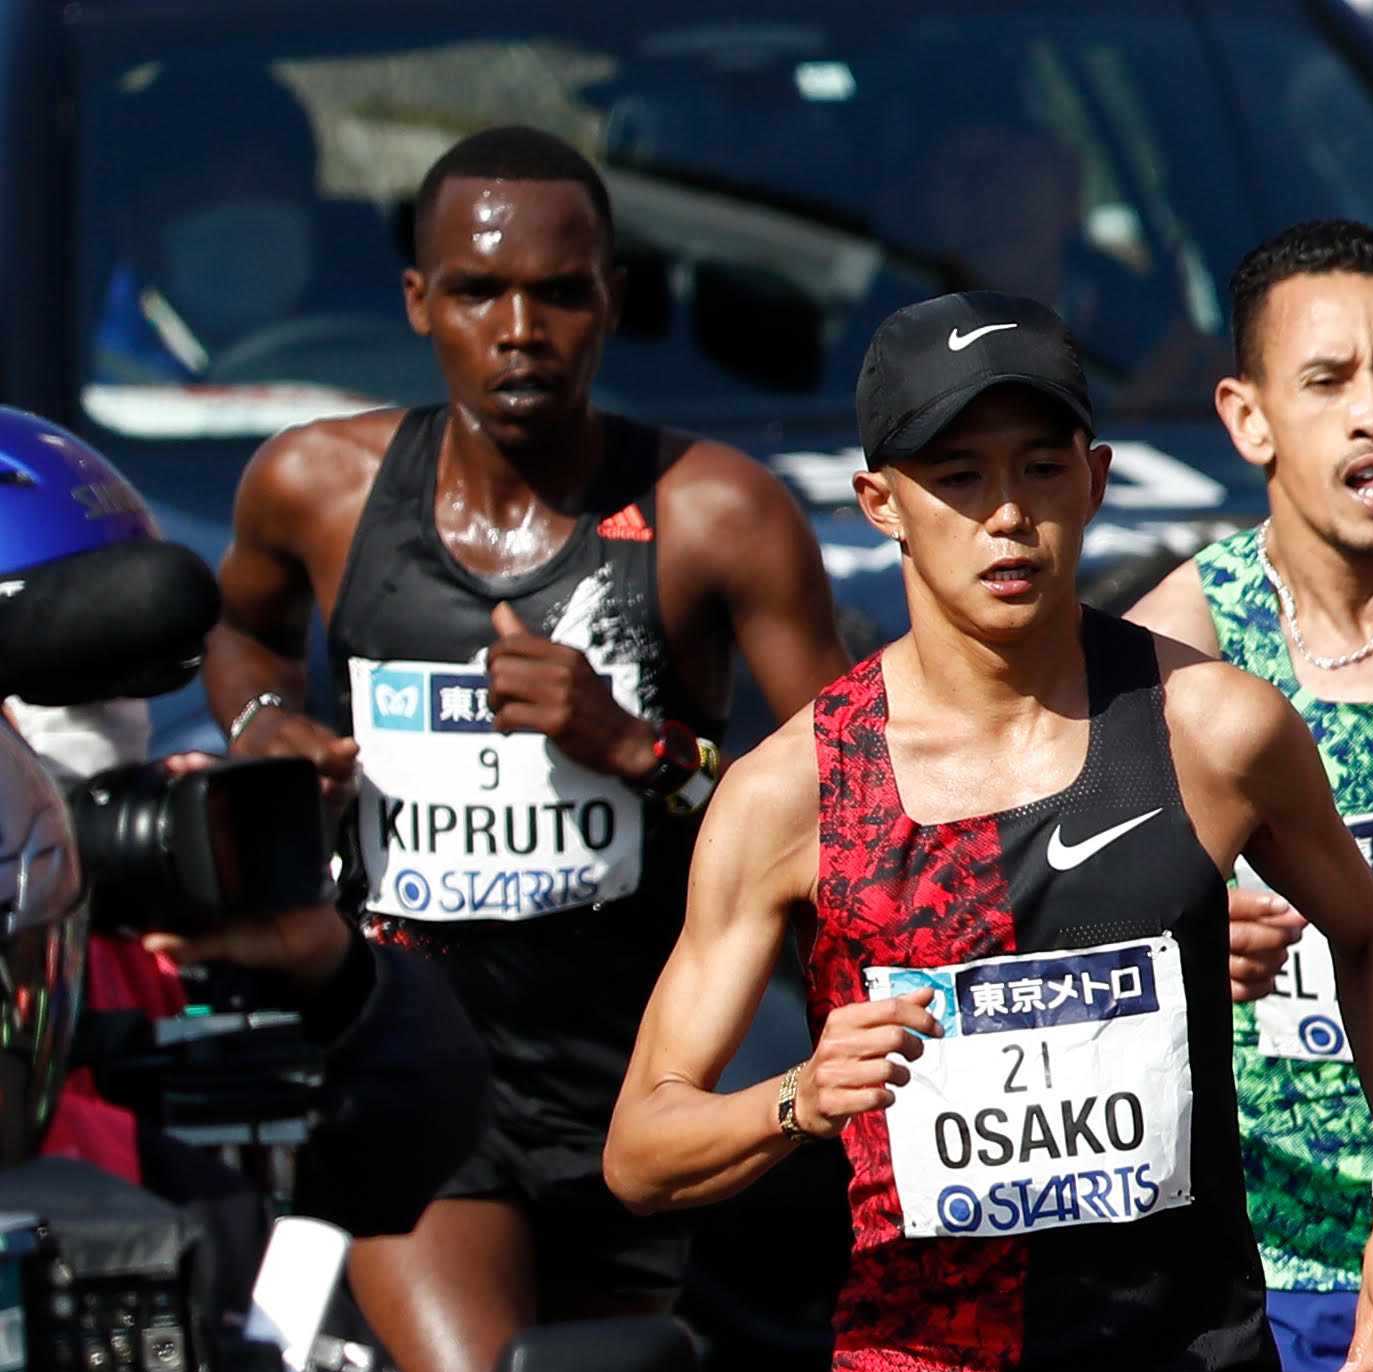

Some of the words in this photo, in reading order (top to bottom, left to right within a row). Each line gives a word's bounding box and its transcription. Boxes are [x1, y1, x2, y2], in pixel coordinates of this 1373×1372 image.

[479, 748, 500, 791] 9
[378, 799, 615, 855] KIPRUTO
[439, 864, 599, 914] STARTS
[969, 966, 1144, 1017] 東京メトロ
[1001, 1040, 1053, 1093] 21
[934, 1091, 1145, 1169] OSAKO
[988, 1162, 1160, 1231] STARTS
